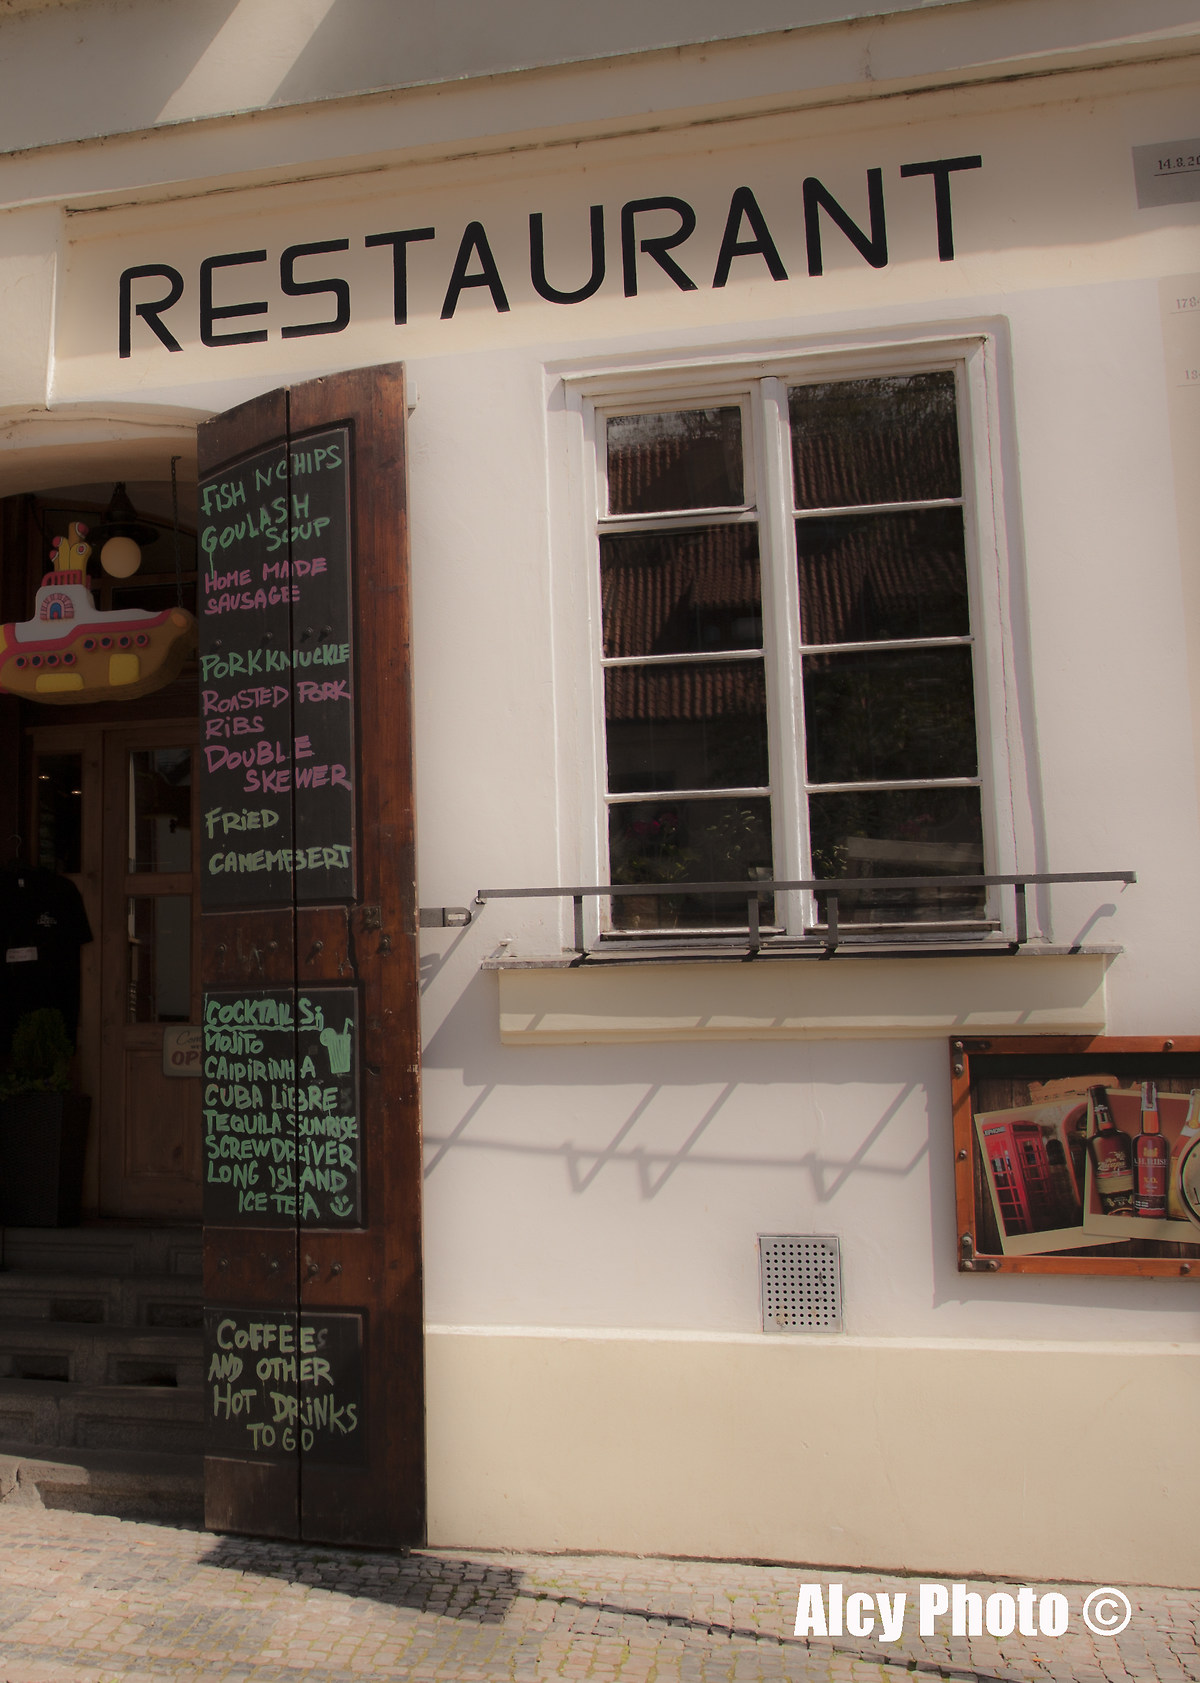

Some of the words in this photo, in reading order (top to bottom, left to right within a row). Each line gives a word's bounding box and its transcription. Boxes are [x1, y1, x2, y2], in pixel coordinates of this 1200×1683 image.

[117, 155, 983, 359] RESTAURANT
[201, 481, 246, 516] FISH
[276, 445, 343, 479] CHIPS
[201, 493, 310, 553] GOULASH
[266, 516, 331, 552] SOUP
[205, 569, 252, 594] HOME
[262, 557, 328, 581] MADE
[204, 585, 301, 615] SAUSAGE
[202, 685, 289, 716] ROASTED
[296, 679, 351, 703] PORK
[204, 735, 314, 774] DOUBLE
[243, 763, 352, 794] SKEWER
[205, 1083, 264, 1110] CUBA
[203, 1109, 282, 1135] TEQUILA
[286, 1113, 359, 1142] SUNRISE
[205, 1134, 358, 1173] SCREWDRIVER
[207, 1160, 260, 1190] LONG
[269, 1164, 348, 1194] ISLAND
[238, 1190, 268, 1214] ICE
[270, 1191, 321, 1220] TEA
[208, 1352, 244, 1383] AND
[256, 1355, 335, 1387] OTHER
[213, 1382, 257, 1420] HOT
[246, 1423, 276, 1451] TO
[282, 1427, 314, 1451] GO
